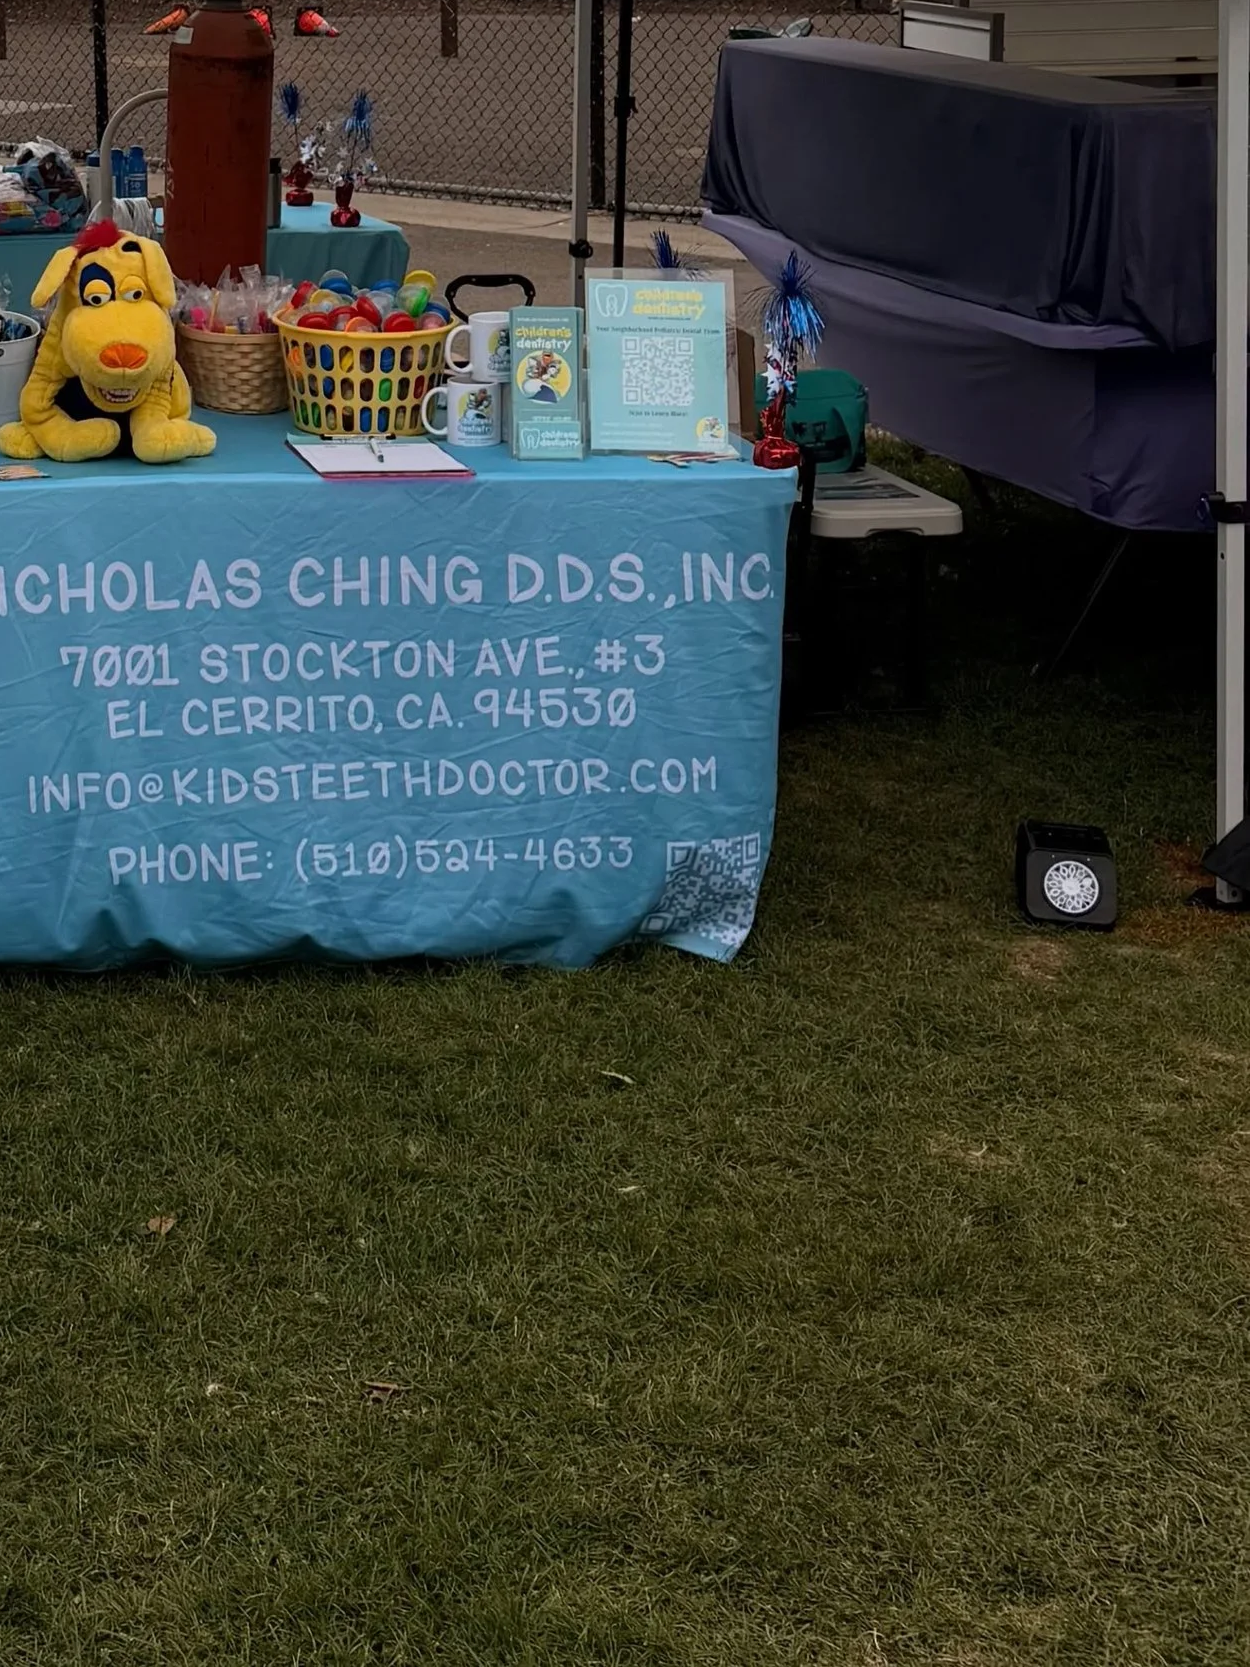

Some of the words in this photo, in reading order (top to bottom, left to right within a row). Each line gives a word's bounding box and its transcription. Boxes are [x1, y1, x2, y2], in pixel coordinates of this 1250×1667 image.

[516, 337, 572, 353] dentistry
[288, 553, 483, 608] CHING
[61, 644, 178, 687] 7001
[199, 638, 456, 684] STOCKTON
[594, 634, 666, 677] #3
[108, 699, 163, 739] EL
[182, 694, 383, 737] CERRITO,
[395, 690, 464, 730] CA.
[474, 686, 637, 730] 94530
[28, 755, 718, 815] INFO@KIDSTEETHDOCTOR.COM
[108, 838, 274, 886] PHONE:
[295, 833, 633, 887] (510)524-4633
